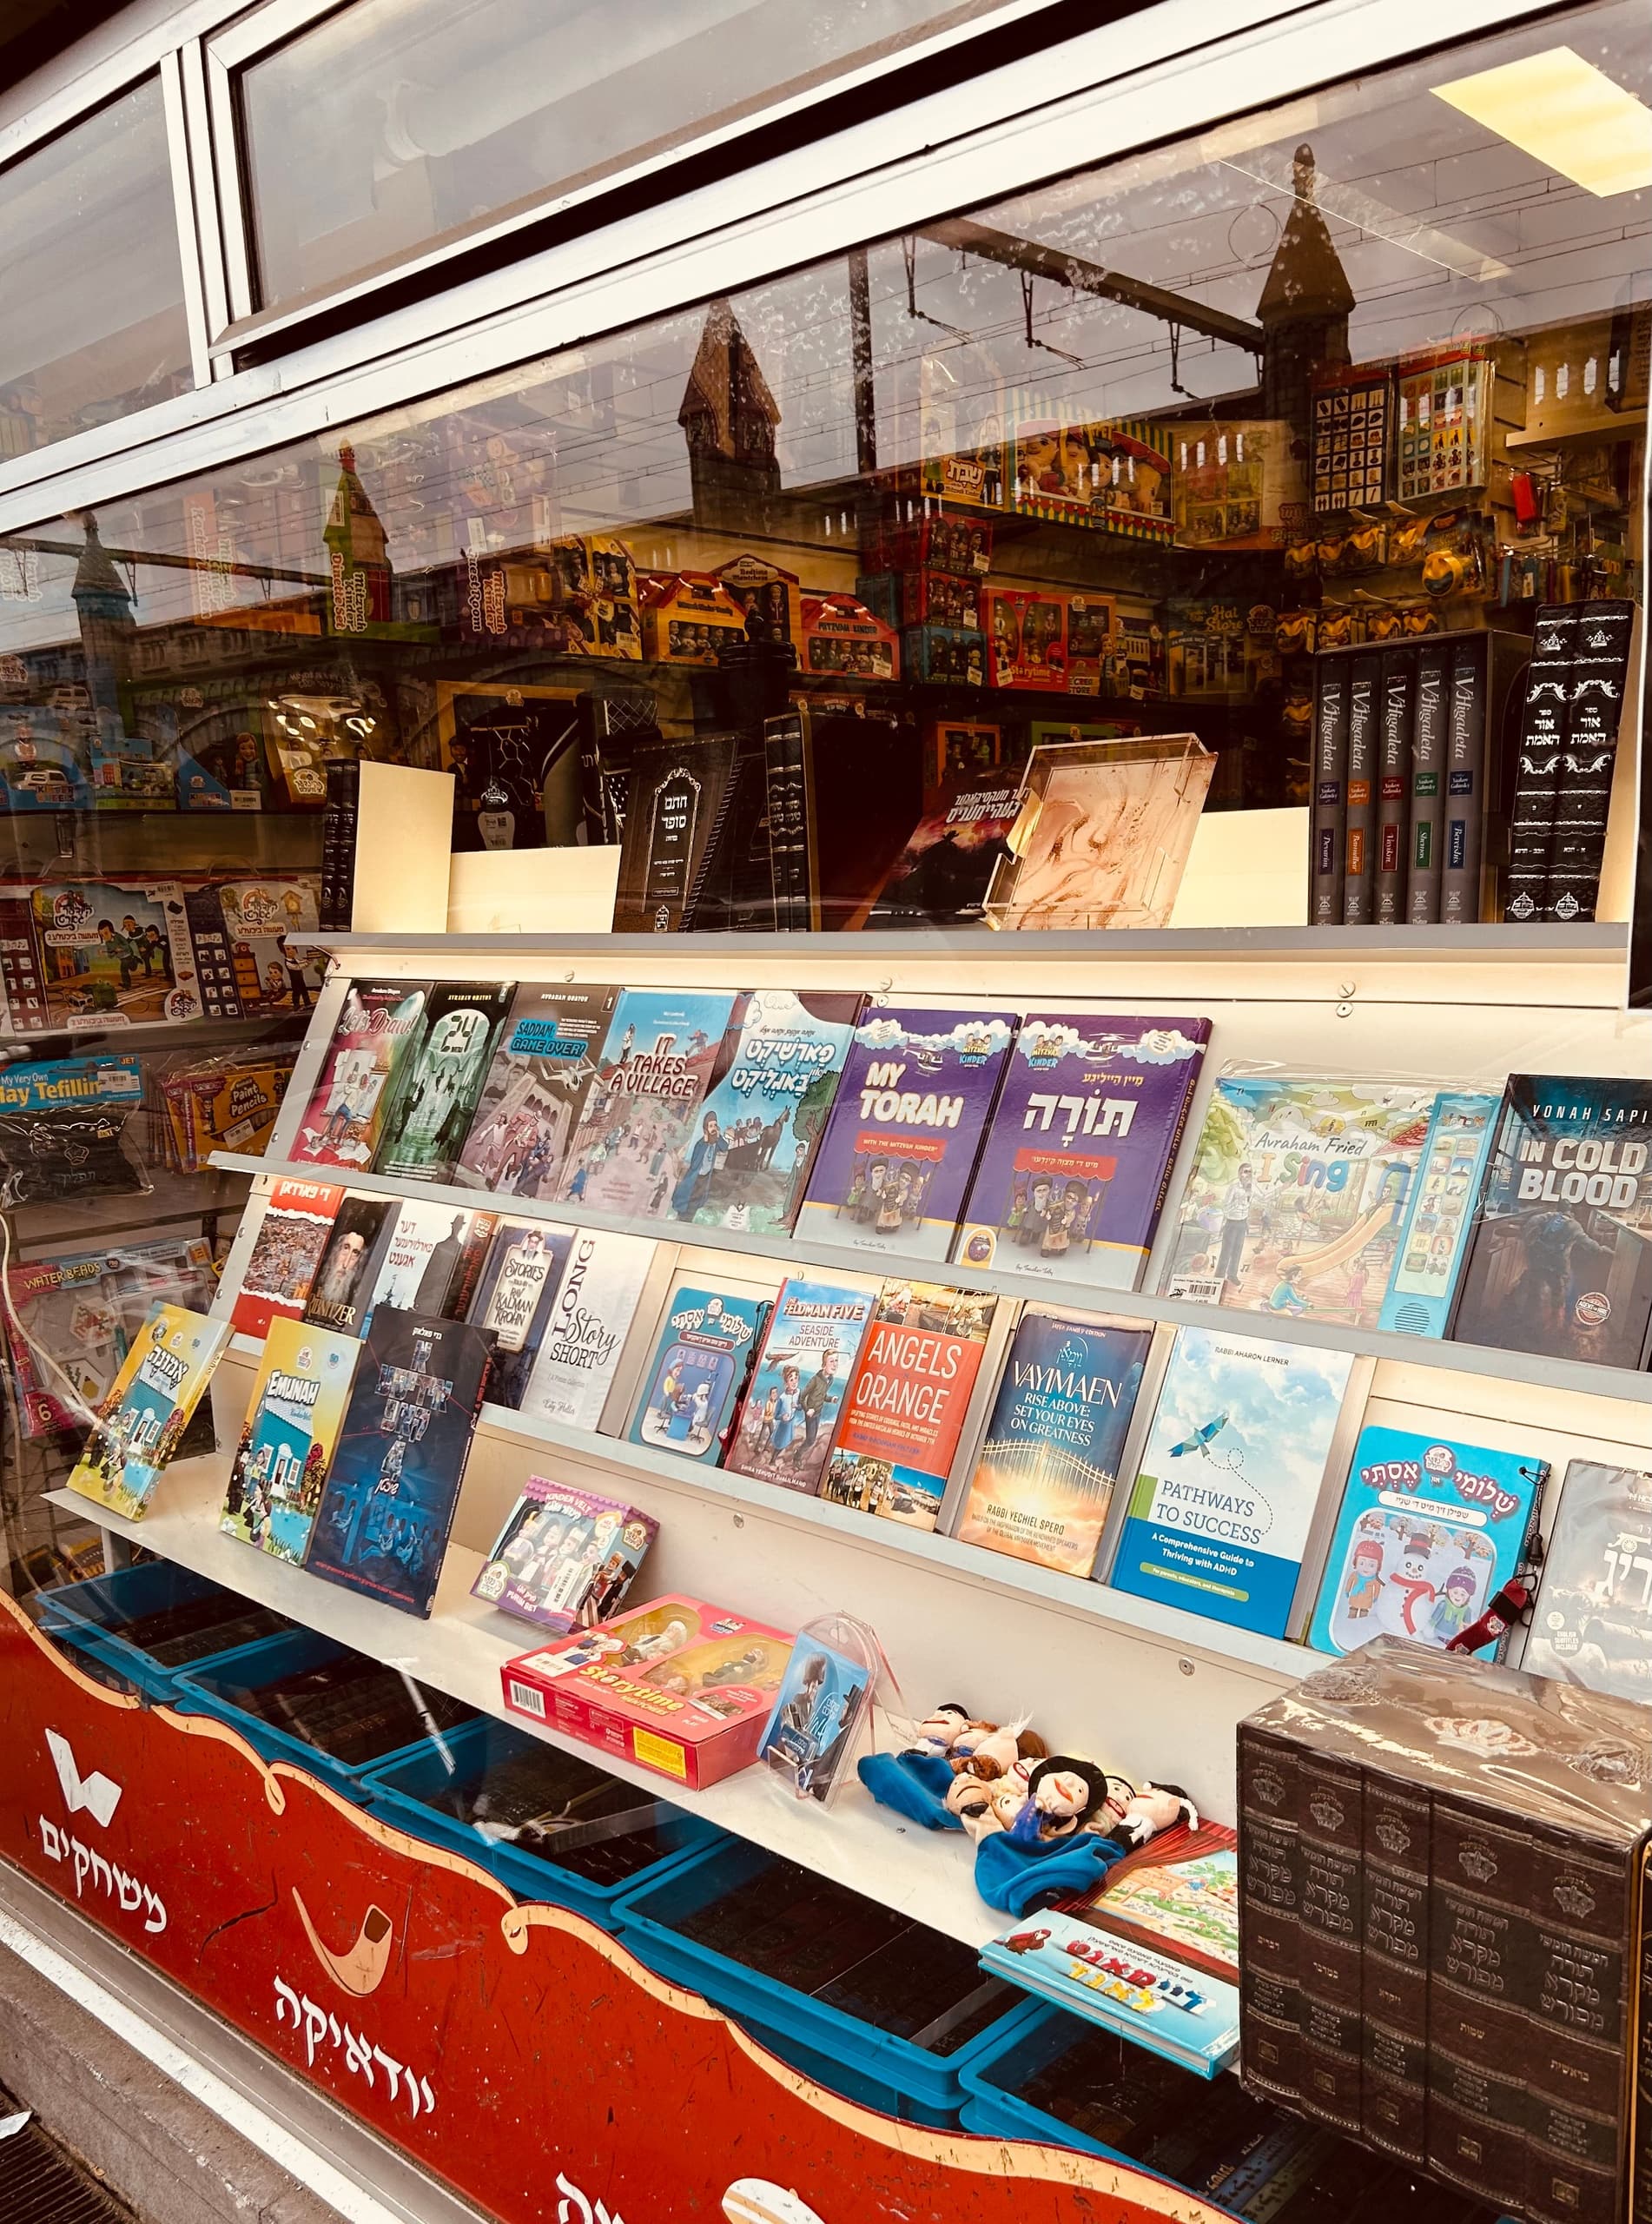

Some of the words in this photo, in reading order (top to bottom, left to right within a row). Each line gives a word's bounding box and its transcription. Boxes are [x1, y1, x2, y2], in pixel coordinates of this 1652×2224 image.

[344, 579, 357, 632] Kinder
[354, 572, 367, 632] Mitzvah
[483, 578, 496, 633] Kinder
[492, 570, 506, 634] Mitzvah
[1535, 718, 1556, 731] אור
[1580, 716, 1602, 728] אור
[1525, 734, 1561, 746] האמת
[1570, 732, 1607, 745] האמת
[664, 795, 689, 811] חתם
[662, 815, 687, 830] סופר
[607, 996, 613, 1009] 1
[337, 1006, 371, 1036] Let's
[369, 1008, 418, 1037] Draw!
[440, 1015, 479, 1053] 24
[511, 1038, 545, 1053] GAME
[546, 1040, 587, 1058] OVER!
[655, 1036, 677, 1055] IT
[120, 1056, 135, 1066] JET
[632, 1054, 688, 1076] TAKES
[959, 1054, 988, 1065] KINDER
[1028, 1057, 1059, 1069] KINDER
[2, 1076, 13, 1086] My
[14, 1074, 33, 1086] Very
[33, 1071, 50, 1082] Own
[610, 1074, 623, 1089] A
[625, 1076, 698, 1098] VILLAGE
[865, 1061, 907, 1089] MY
[34, 1076, 102, 1101] Tefillin
[232, 1082, 260, 1102] Paint
[229, 1094, 268, 1118] Pencils
[859, 1089, 964, 1129] TORAH
[1531, 1103, 1593, 1122] YONAH
[862, 1138, 877, 1147] WITH
[889, 1141, 914, 1150] MITZVAH
[1254, 1132, 1321, 1153] Avraham
[1324, 1137, 1369, 1156] Fried
[1519, 1140, 1547, 1163] IN
[1550, 1137, 1649, 1176] COLD
[1257, 1152, 1277, 1183] I
[1279, 1151, 1351, 1193] Sing
[1517, 1168, 1641, 1209] BLOOD
[23, 1270, 63, 1291] WATER
[66, 1261, 102, 1281] BEADS
[505, 1258, 545, 1282] STORIES
[552, 1239, 596, 1339] LONG
[495, 1292, 534, 1314] KALMAN
[783, 1302, 830, 1319] FELDMAN
[831, 1304, 866, 1321] FIVE
[493, 1308, 526, 1327] KROHN
[563, 1307, 622, 1367] Story
[788, 1334, 841, 1349] ADVENTURE
[798, 1324, 835, 1337] SEASIDE
[549, 1342, 598, 1370] SHORT
[868, 1330, 963, 1380] ANGELS
[1214, 1346, 1234, 1358] RABBI
[1234, 1349, 1263, 1363] AHARON
[1263, 1354, 1290, 1367] LERNER
[267, 1369, 321, 1407] EMUNAH
[1014, 1360, 1124, 1410] VAYIMAEN
[856, 1371, 951, 1425] ORANGE
[1024, 1392, 1047, 1408] RISE
[1048, 1397, 1092, 1418] ABOVE:
[37, 1402, 52, 1422] 6
[1014, 1404, 1034, 1419] SET
[1034, 1408, 1066, 1426] YOUR
[1067, 1416, 1095, 1433] EYES
[1010, 1417, 1028, 1433] ON
[1028, 1421, 1093, 1447] GREATNESS
[545, 1493, 574, 1508] KINDER
[573, 1498, 593, 1514] VELT
[1160, 1479, 1256, 1519] PATHWAYS
[987, 1504, 1008, 1519] RABBI
[1009, 1510, 1038, 1528] YECHIEL
[1039, 1519, 1066, 1536] SPERO
[1156, 1502, 1181, 1522] TO
[1182, 1509, 1261, 1546] SUCCESS
[1152, 1532, 1159, 1542] A
[1158, 1533, 1219, 1559] Comprehensive
[1219, 1550, 1246, 1565] Guide
[1246, 1557, 1256, 1568] to
[1162, 1546, 1195, 1566] Thriving
[1194, 1555, 1213, 1570] with
[1213, 1561, 1239, 1577] ADHD
[506, 1591, 526, 1608] PURIM
[524, 1600, 539, 1614] SET
[39, 1813, 169, 1934] משחקים
[1550, 1954, 1595, 1982] תורה
[1543, 1970, 1601, 2005] מקרא
[1539, 1992, 1605, 2030] מפורש
[1459, 2022, 1486, 2041] שמות
[273, 1974, 436, 2121] יודאיקה
[1550, 2058, 1590, 2083] בראשית
